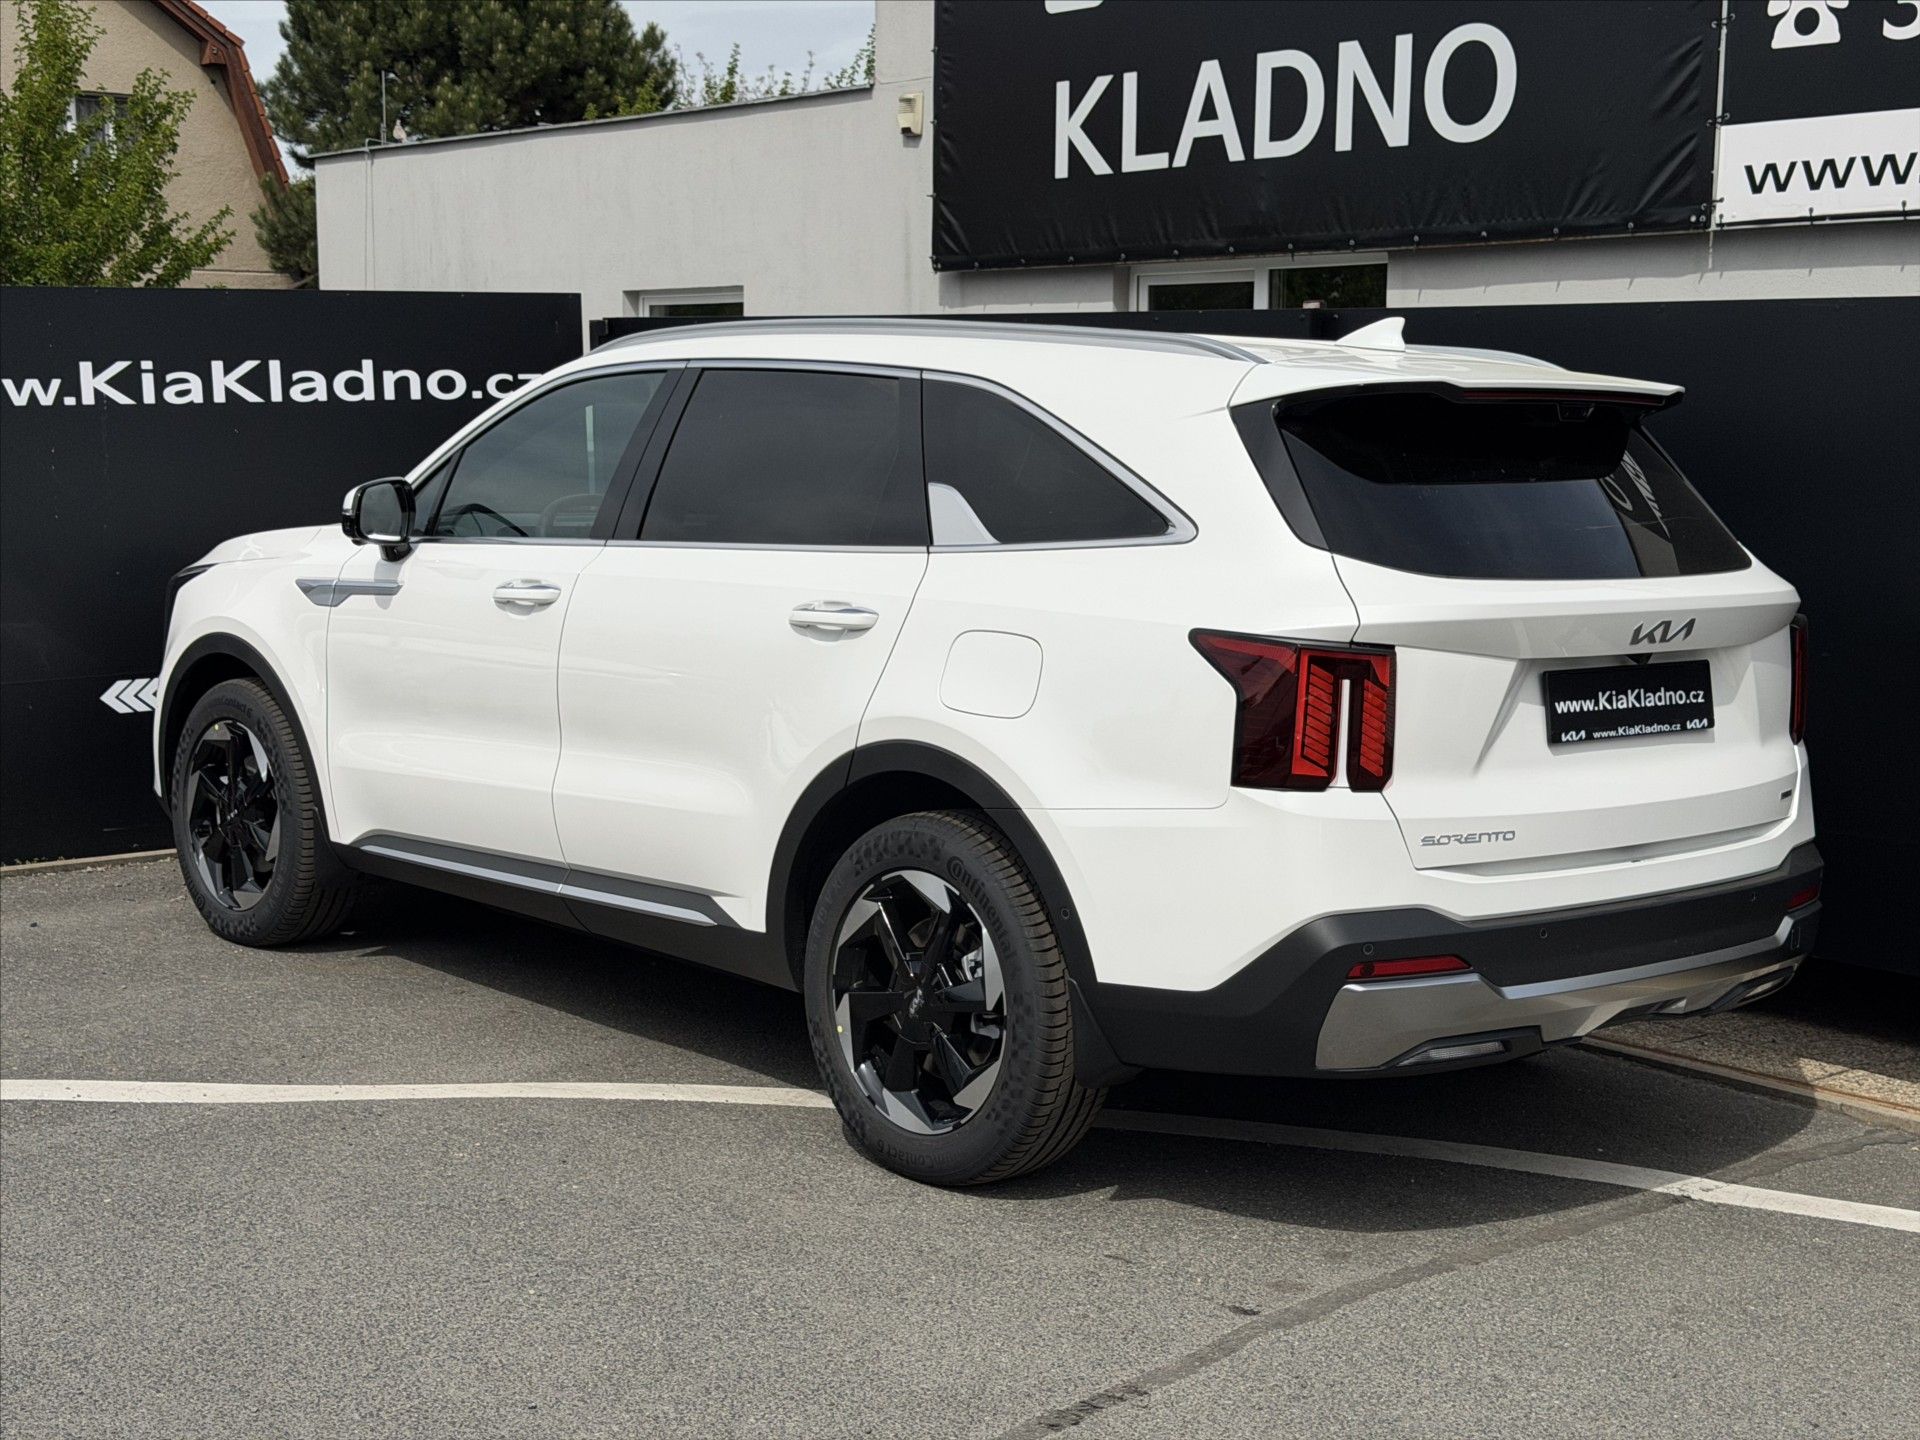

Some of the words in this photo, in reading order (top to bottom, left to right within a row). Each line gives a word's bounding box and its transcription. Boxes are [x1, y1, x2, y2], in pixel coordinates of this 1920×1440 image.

[1054, 22, 1518, 179] KLADNO
[1744, 152, 1920, 195] www
[1629, 618, 1696, 646] KIA
[1555, 687, 1705, 714] www.KiaKladno.cz
[1592, 722, 1682, 739] www.KiaKladno.cz
[1420, 830, 1516, 847] SORENTO
